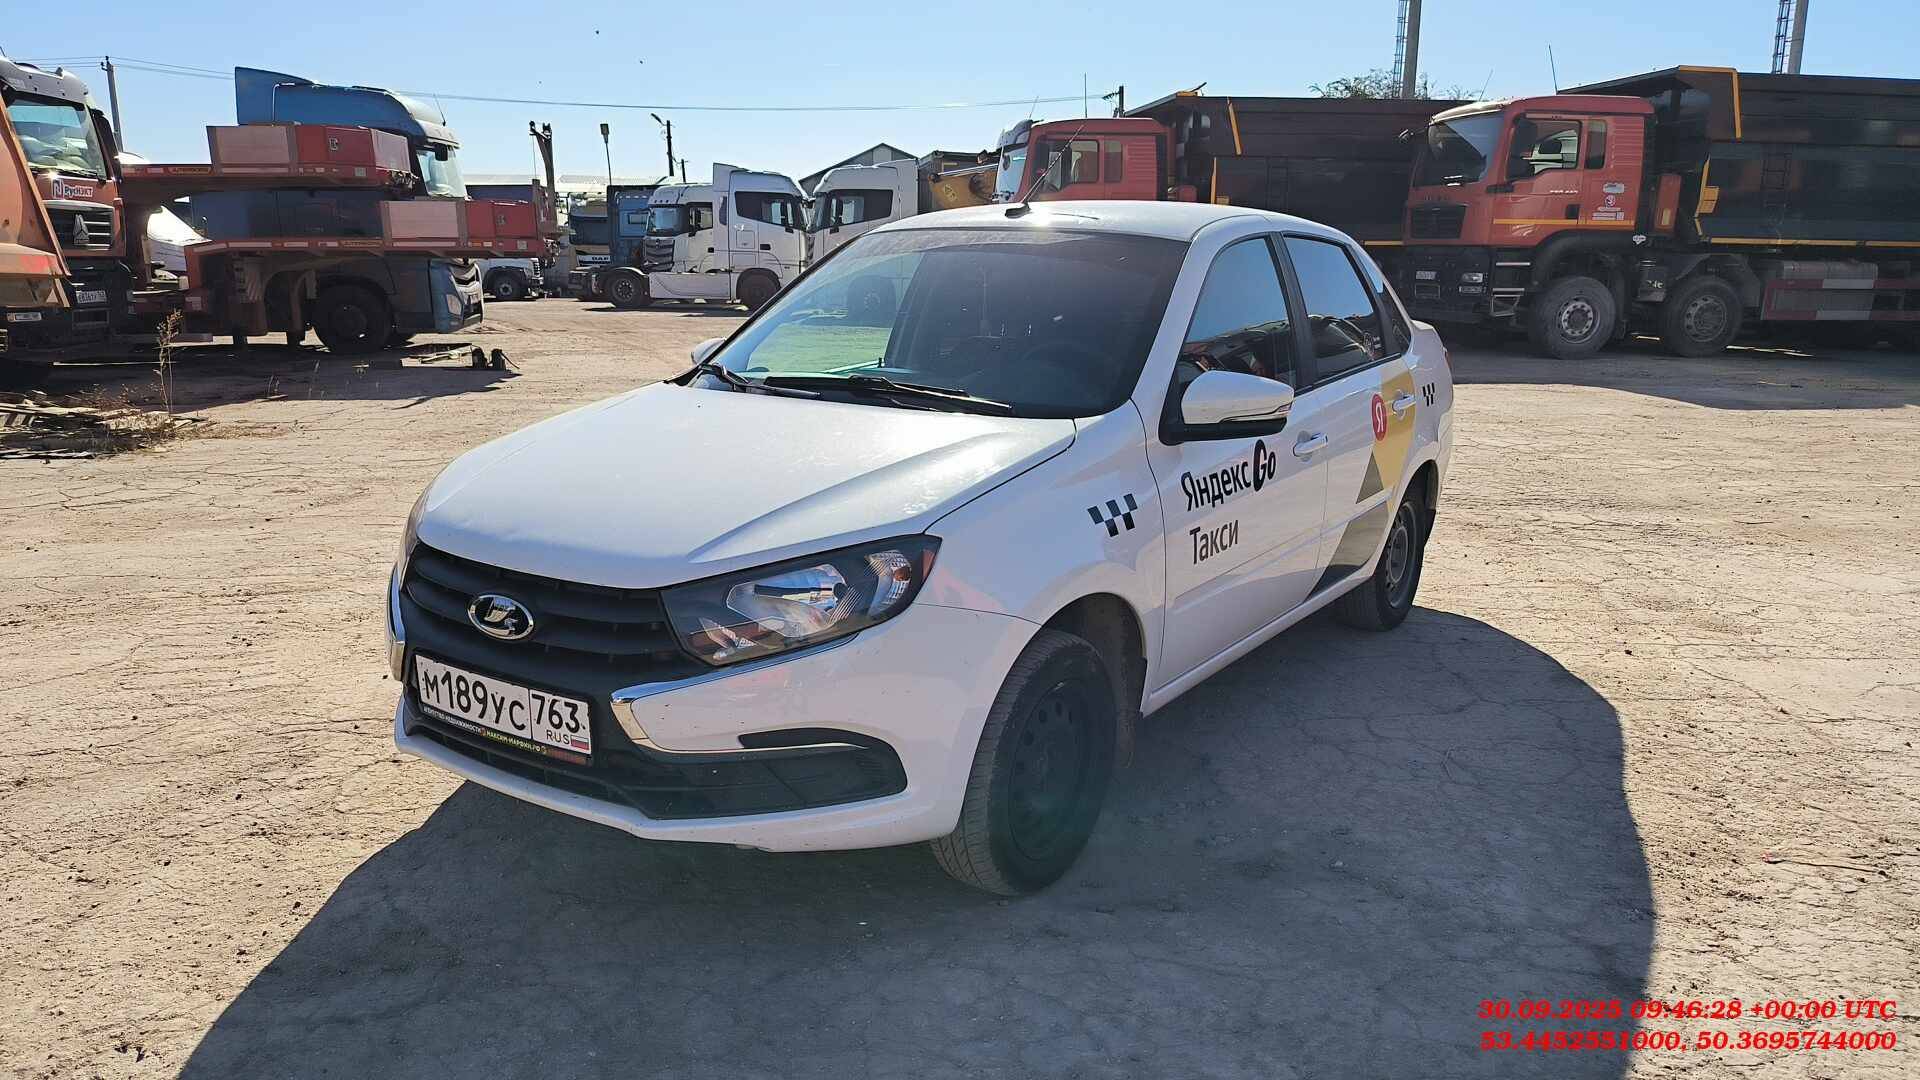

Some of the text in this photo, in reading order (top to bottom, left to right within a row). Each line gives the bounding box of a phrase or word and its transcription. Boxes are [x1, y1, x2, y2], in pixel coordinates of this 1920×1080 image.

[1181, 439, 1276, 512] Яндекс Go
[1189, 519, 1239, 564] Такси
[423, 671, 580, 733] М189УС 763
[546, 729, 570, 745] RUS
